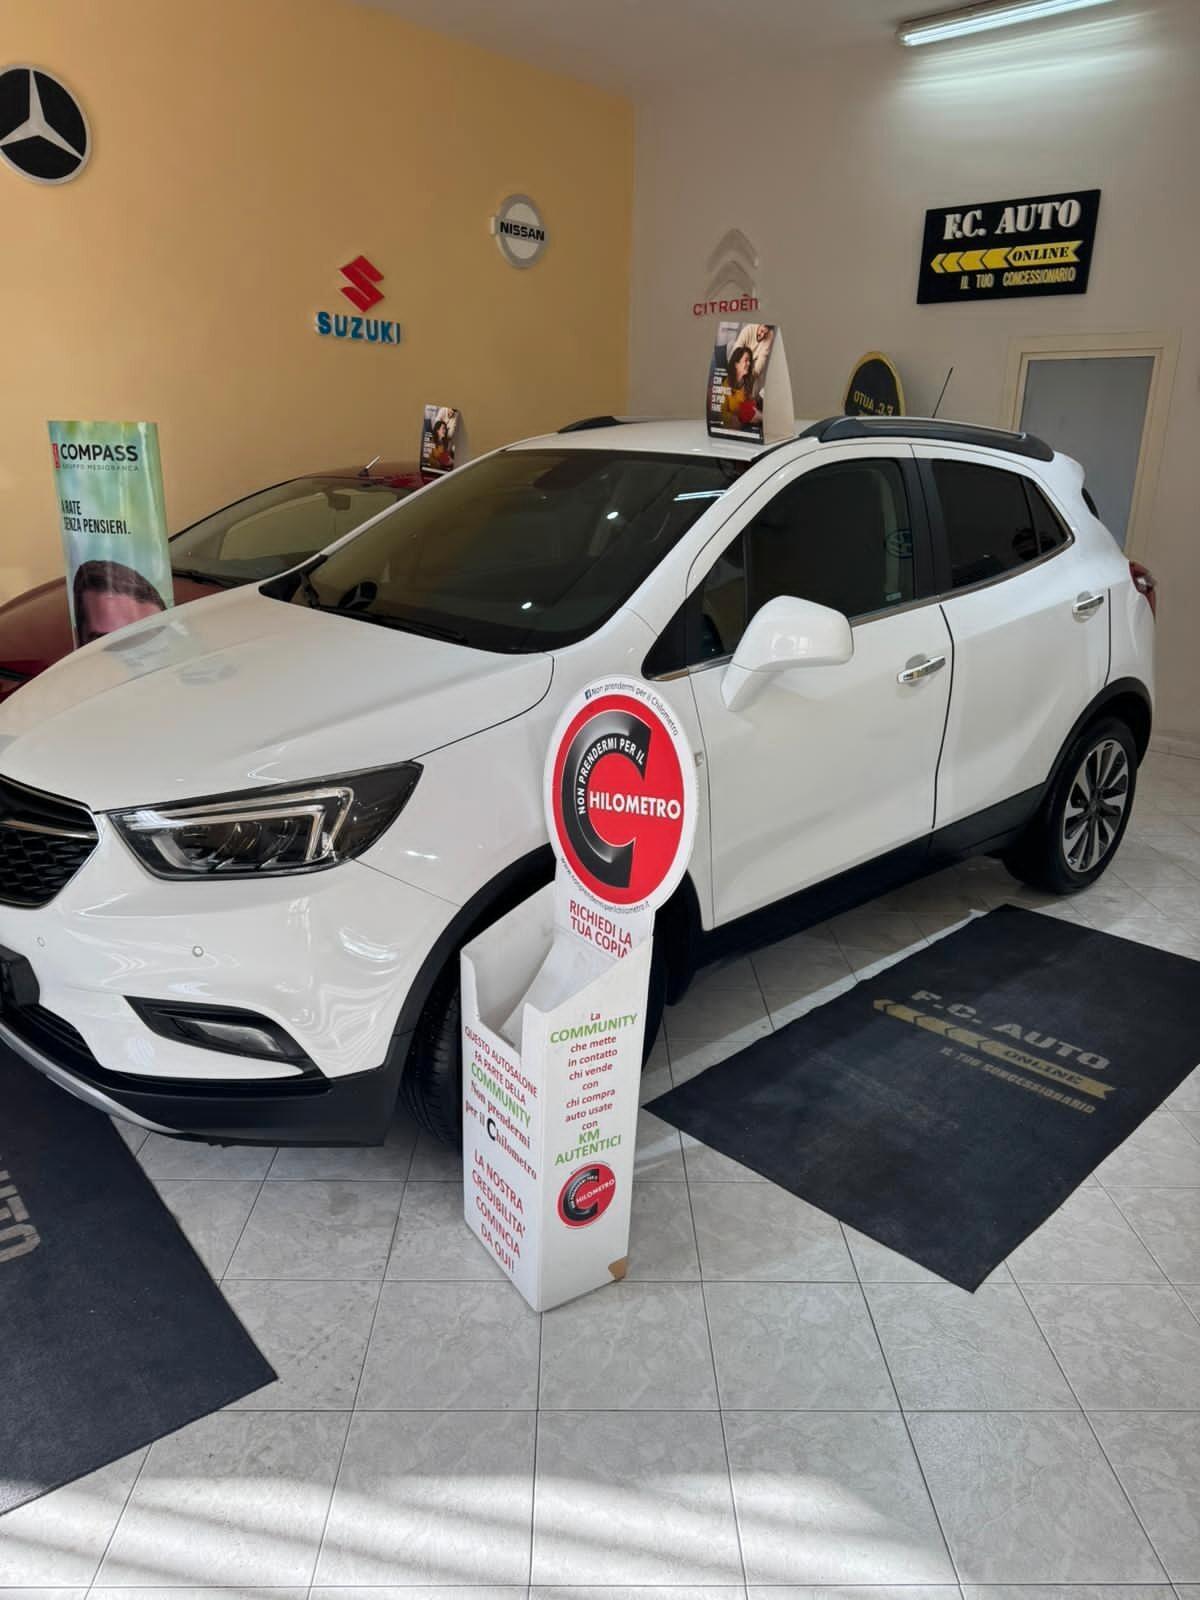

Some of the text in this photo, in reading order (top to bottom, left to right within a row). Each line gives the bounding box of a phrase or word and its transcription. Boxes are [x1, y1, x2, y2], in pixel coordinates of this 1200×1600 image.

[500, 221, 545, 242] NISSAN
[943, 199, 1081, 240] F.C. AUTO
[1012, 246, 1070, 262] ONLINE
[959, 266, 1077, 290] IL TUO CONCESSIONARIO
[316, 311, 401, 345] SUZUKI
[60, 443, 139, 462] COMPASS
[83, 519, 132, 535] PENSIERI.
[577, 737, 645, 815] NON PRENDERMI PER IL
[570, 900, 633, 949] RICHIEDI LA
[571, 916, 593, 941] TUA
[550, 1014, 638, 1044] COMMUNITY
[590, 1012, 601, 1021] La
[568, 1048, 618, 1067] in contatto
[570, 1036, 617, 1053] che mette
[992, 1023, 1110, 1070] AUTO
[464, 1025, 538, 1098] QUESTO AUTOSALONE
[569, 1062, 613, 1080] chi vende
[1003, 1050, 1082, 1086] ONLINE
[471, 1062, 531, 1128] COMMUNITY
[483, 1058, 504, 1085] PARTE
[504, 1078, 526, 1106] DELLA
[582, 1080, 599, 1090] con
[564, 1102, 614, 1123] auto usate
[566, 1089, 616, 1109] chi compra
[487, 1099, 531, 1149] prendermi
[579, 1128, 601, 1145] KM
[582, 1120, 599, 1131] con
[486, 1117, 537, 1180] Chilometro
[554, 1134, 622, 1167] AUTENTICI
[474, 1148, 524, 1215] LA NOSTRA
[472, 1168, 526, 1239] CREDIBILITA'
[475, 1195, 521, 1259] COMINCIA
[481, 1222, 514, 1274] DA QUI!
